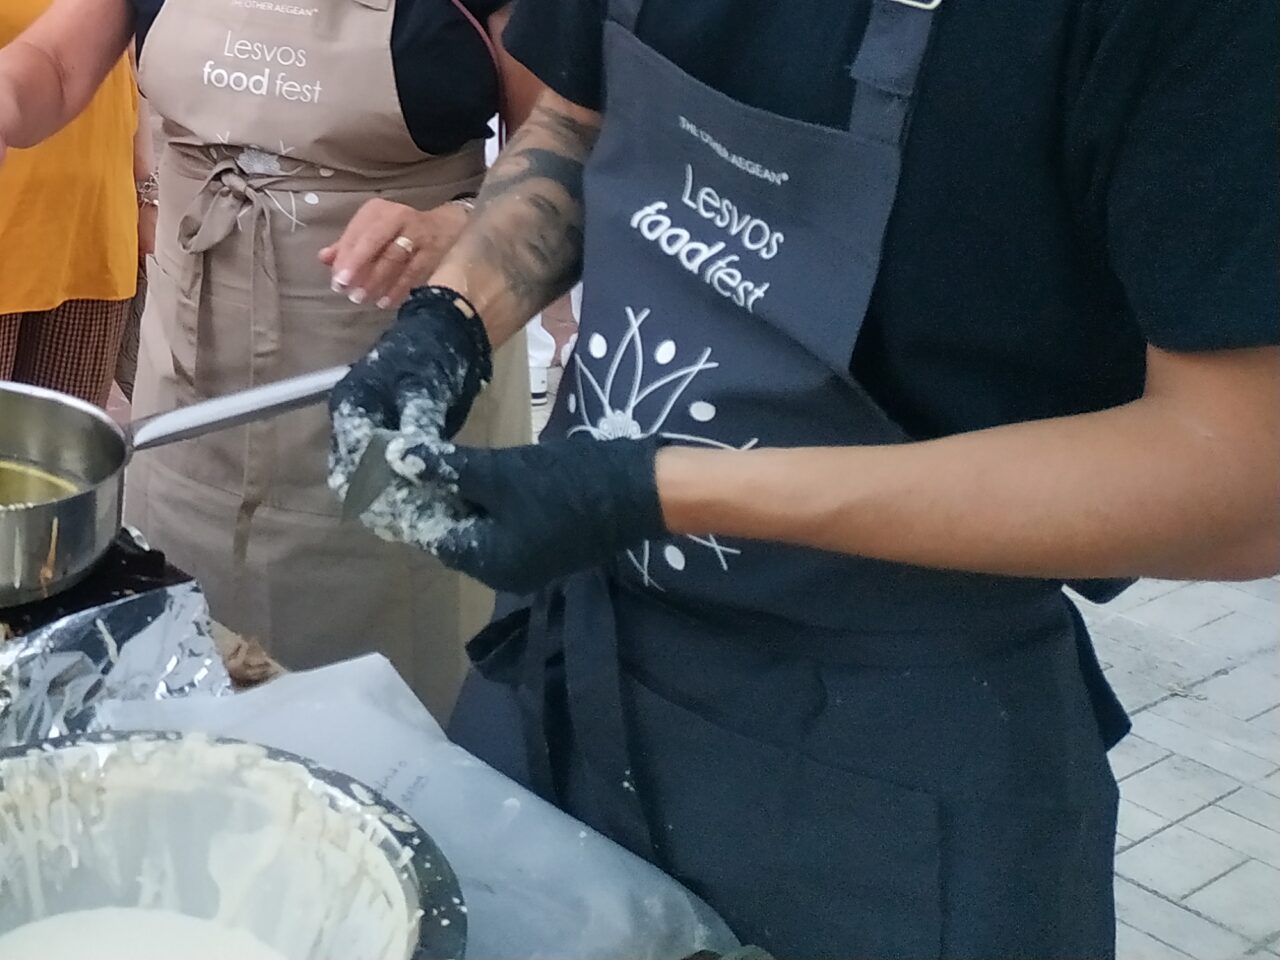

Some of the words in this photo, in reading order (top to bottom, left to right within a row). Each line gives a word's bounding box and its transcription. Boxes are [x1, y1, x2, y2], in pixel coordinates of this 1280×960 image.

[203, 60, 270, 95] food
[275, 73, 322, 103] fest
[224, 30, 306, 67] Lesvos
[682, 163, 784, 259] Lesvos
[630, 201, 726, 274] food
[705, 254, 770, 313] fest
